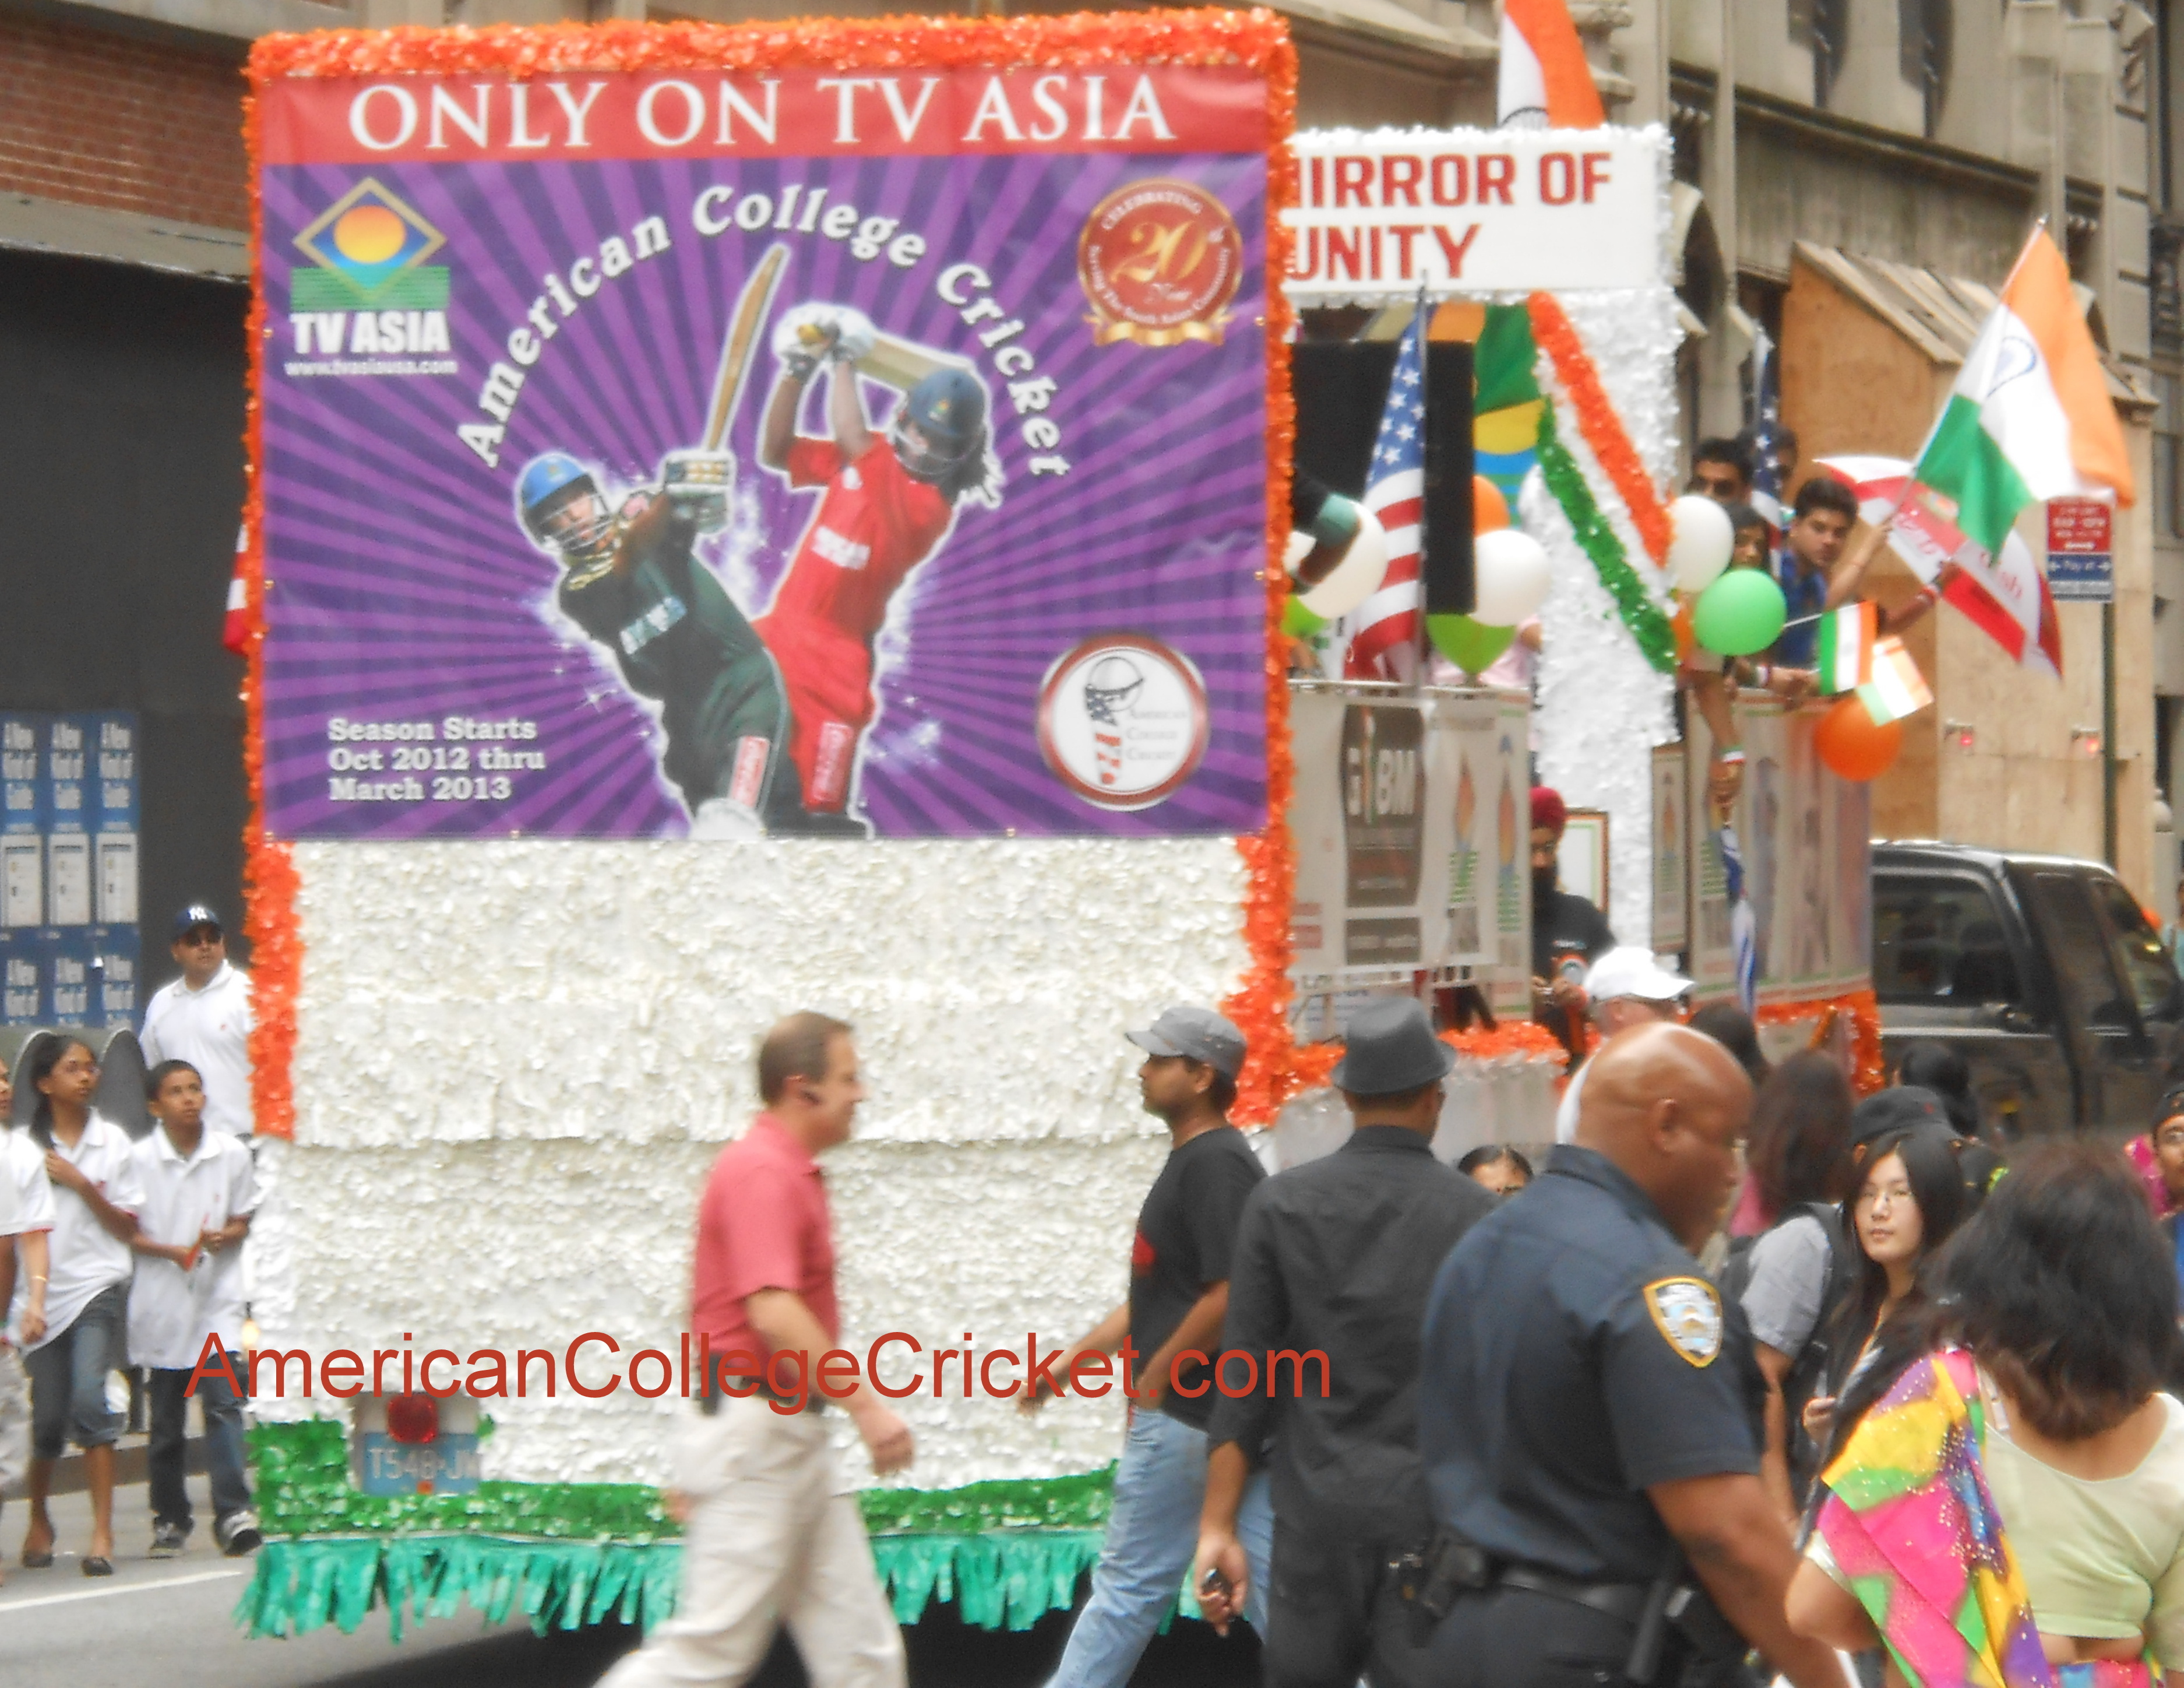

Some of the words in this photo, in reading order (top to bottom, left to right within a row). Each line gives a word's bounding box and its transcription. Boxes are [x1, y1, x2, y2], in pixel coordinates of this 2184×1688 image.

[349, 82, 608, 150] ONLY
[636, 80, 781, 146] ON
[817, 77, 940, 145] TV
[962, 74, 1176, 142] ASIA
[1295, 153, 1516, 208] IRROR
[1538, 151, 1612, 206] OF
[1109, 220, 1208, 283] 20
[290, 311, 347, 354] TV
[350, 310, 451, 353] ASIA
[457, 215, 672, 468] American
[692, 183, 927, 267] College
[936, 262, 1070, 477] Cricket
[327, 717, 435, 741] Season
[442, 716, 537, 740] Starts
[329, 747, 384, 771] Oct
[392, 747, 470, 770] 2012
[478, 746, 546, 770] thru
[329, 777, 425, 801] March
[432, 777, 512, 801] 2013
